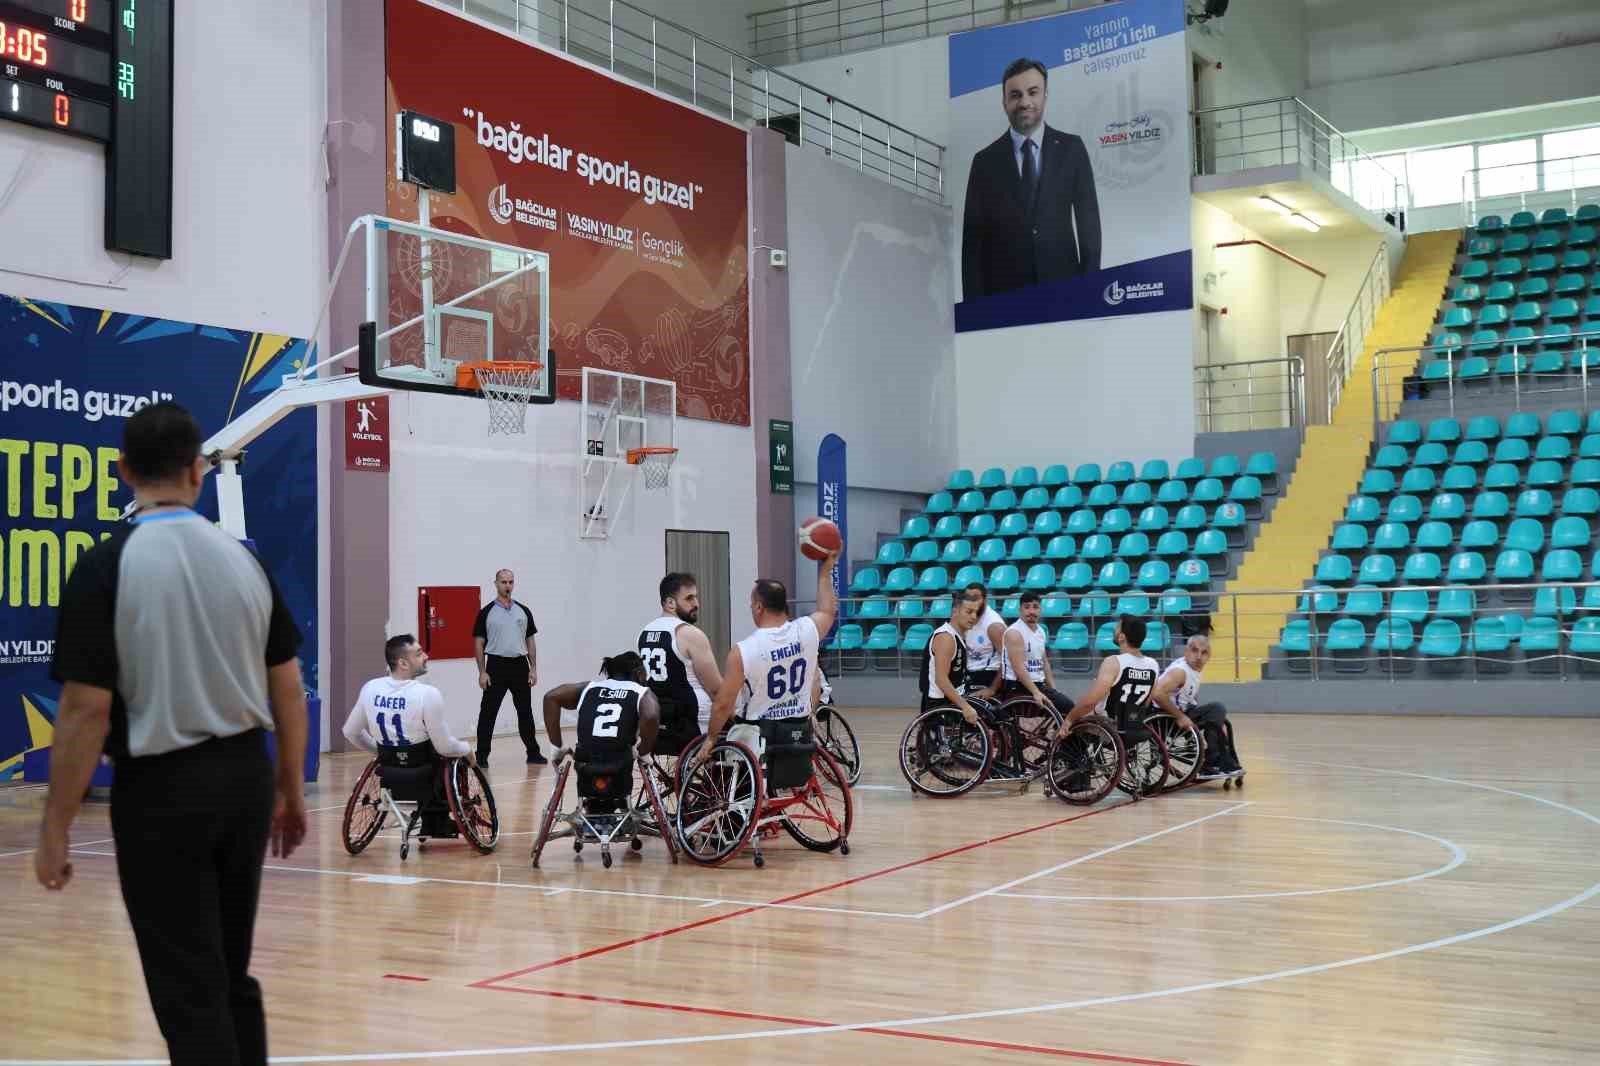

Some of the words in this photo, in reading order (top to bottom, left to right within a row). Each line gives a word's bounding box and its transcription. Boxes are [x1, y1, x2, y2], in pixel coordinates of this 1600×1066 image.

[54, 16, 76, 31] SCORE
[5, 64, 18, 76] SET
[46, 78, 65, 92] FOUL
[11, 83, 19, 112] 1
[54, 94, 70, 126] 0
[1129, 127, 1161, 140] YILDIZ
[576, 152, 641, 194] sporla
[515, 198, 557, 219] BAĞCILAR
[567, 212, 599, 235] YASİN
[600, 221, 634, 244] YILDIZ
[642, 231, 685, 257] Gençlik
[352, 432, 383, 441] VOLEYBOL
[770, 642, 802, 662] ENGİN
[767, 657, 807, 700] 60
[374, 694, 407, 710] CAFER
[1119, 683, 1152, 706] 17
[375, 711, 413, 747] 11
[592, 703, 623, 738] 2
